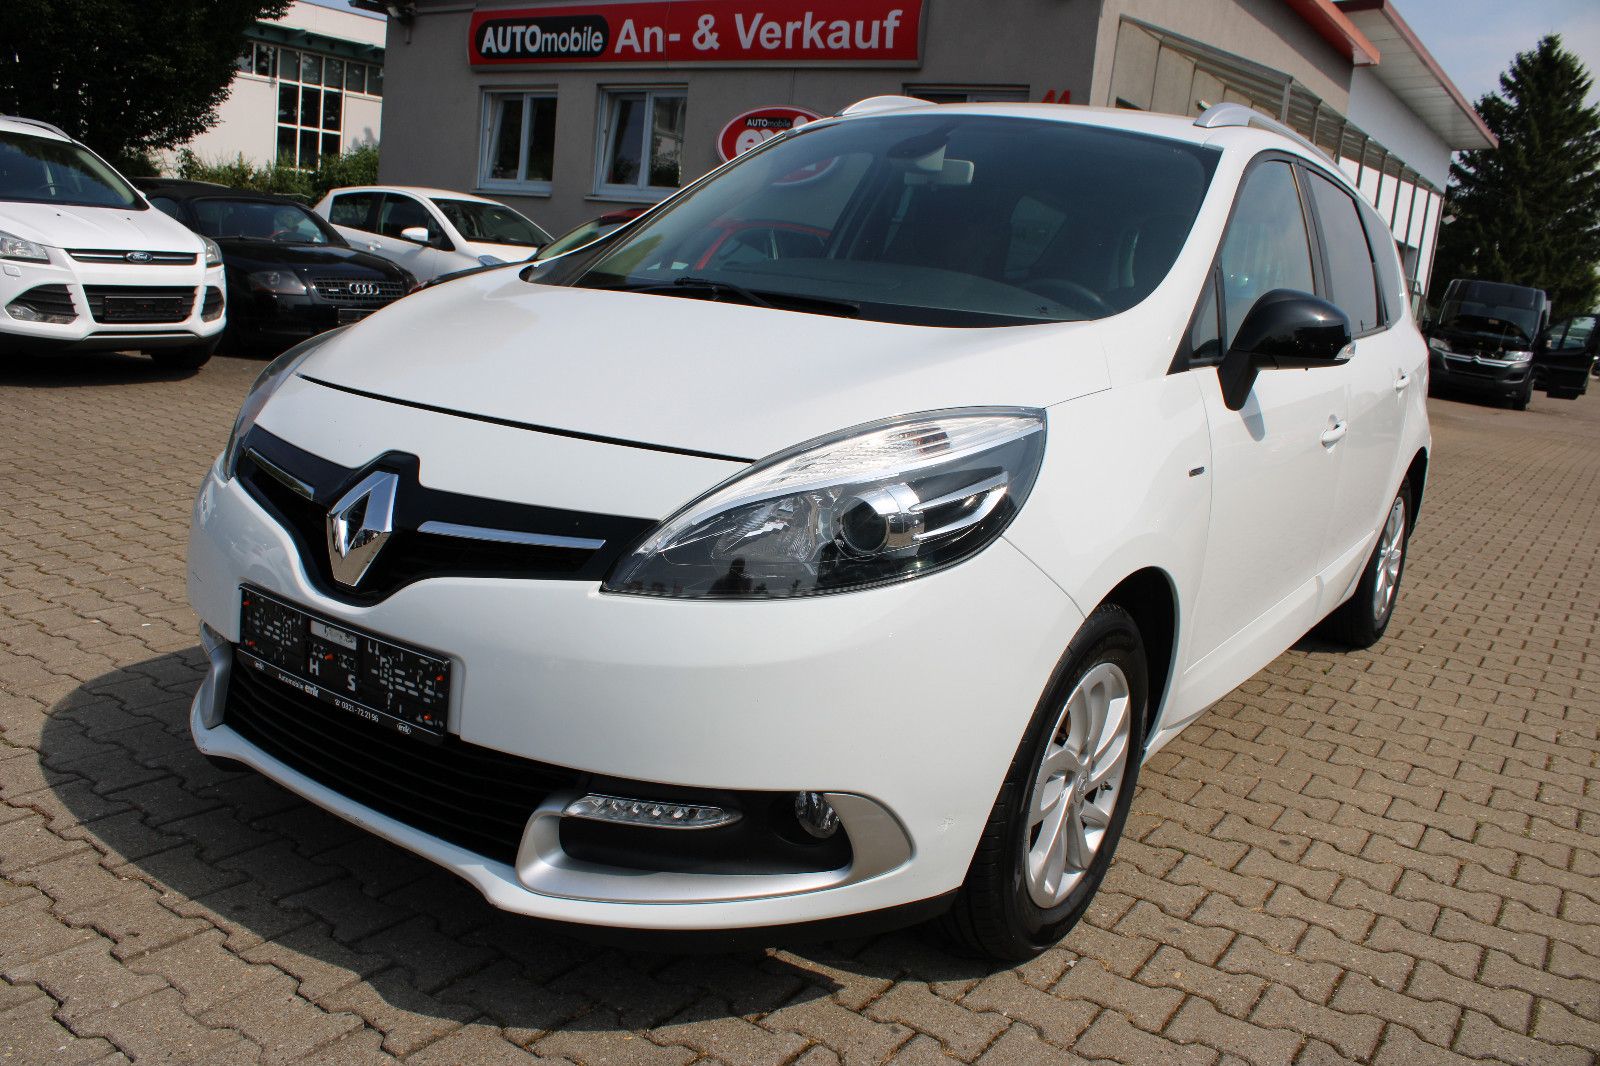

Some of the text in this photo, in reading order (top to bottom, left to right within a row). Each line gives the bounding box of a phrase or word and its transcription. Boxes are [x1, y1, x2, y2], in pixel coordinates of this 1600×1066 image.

[481, 9, 903, 53] AUTOmobile An- & Verkauf
[746, 118, 791, 128] AUTOmobile
